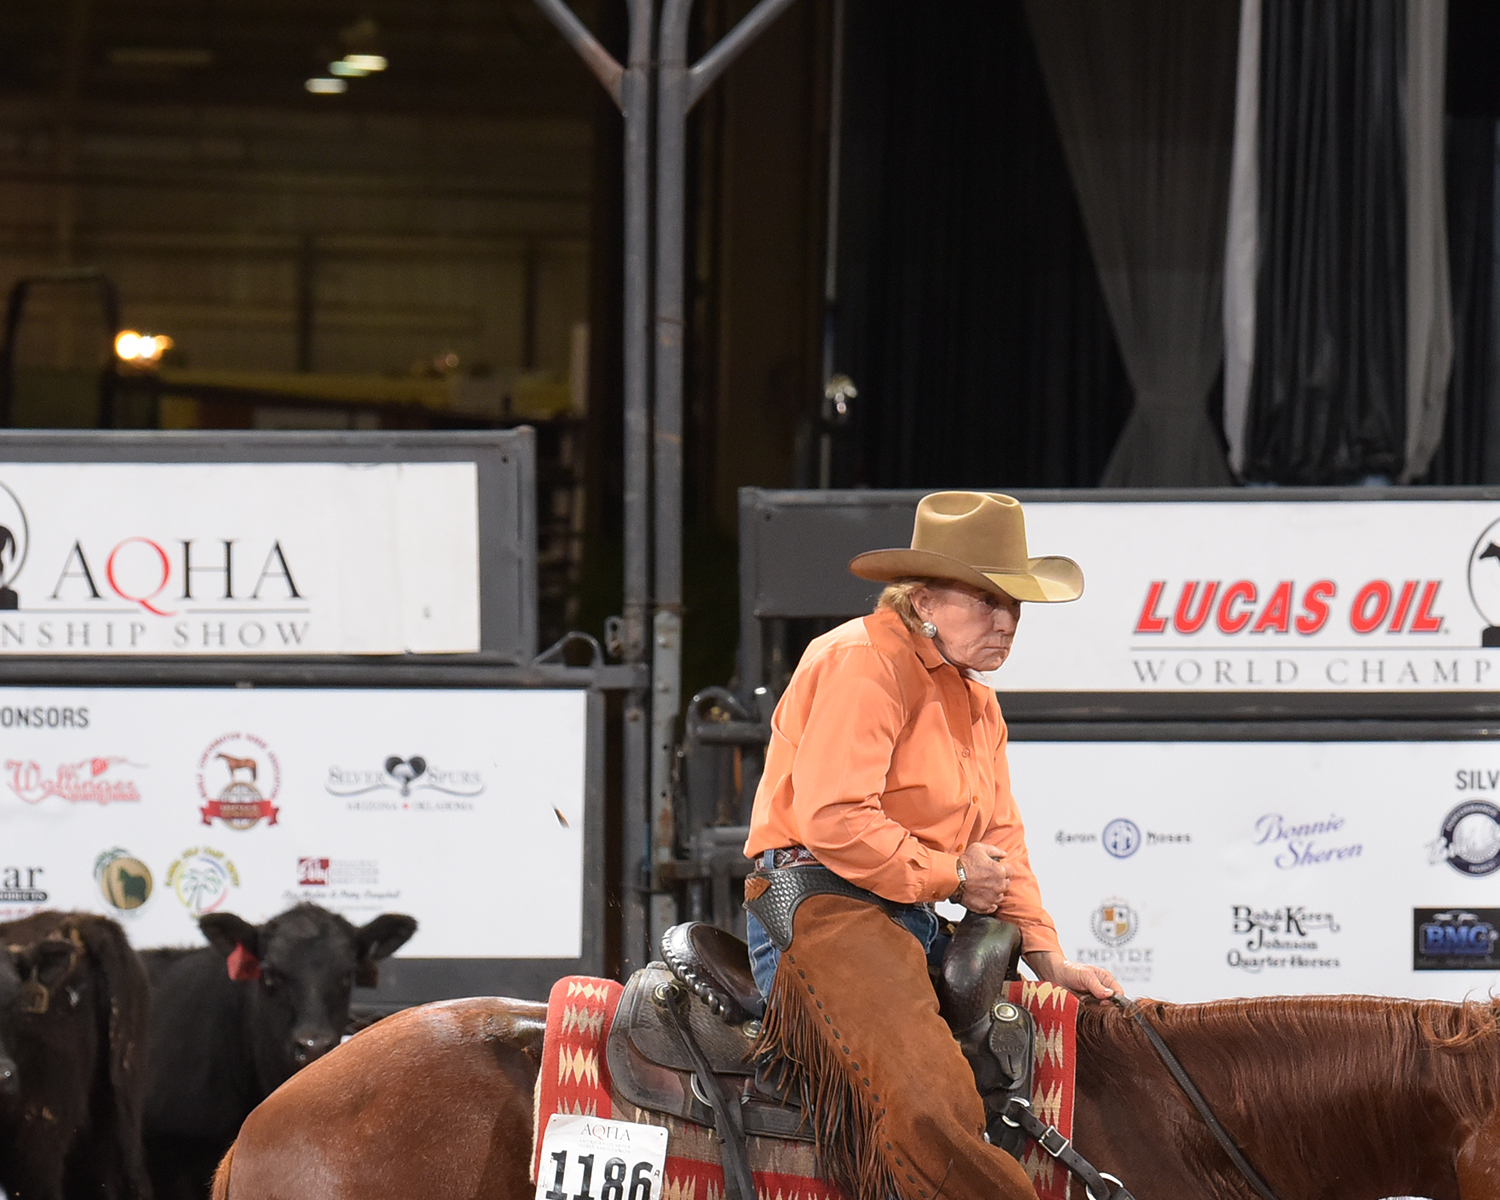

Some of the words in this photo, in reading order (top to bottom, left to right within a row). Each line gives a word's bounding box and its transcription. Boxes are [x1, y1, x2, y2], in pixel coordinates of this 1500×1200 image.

[51, 536, 304, 616] AQHA
[1132, 579, 1336, 637] LUCAS
[1349, 579, 1443, 636] OIL
[174, 621, 309, 647] SHOW
[1132, 659, 1299, 685] WORLD
[1254, 813, 1346, 845] Bonnie
[580, 1123, 631, 1140] AQHA
